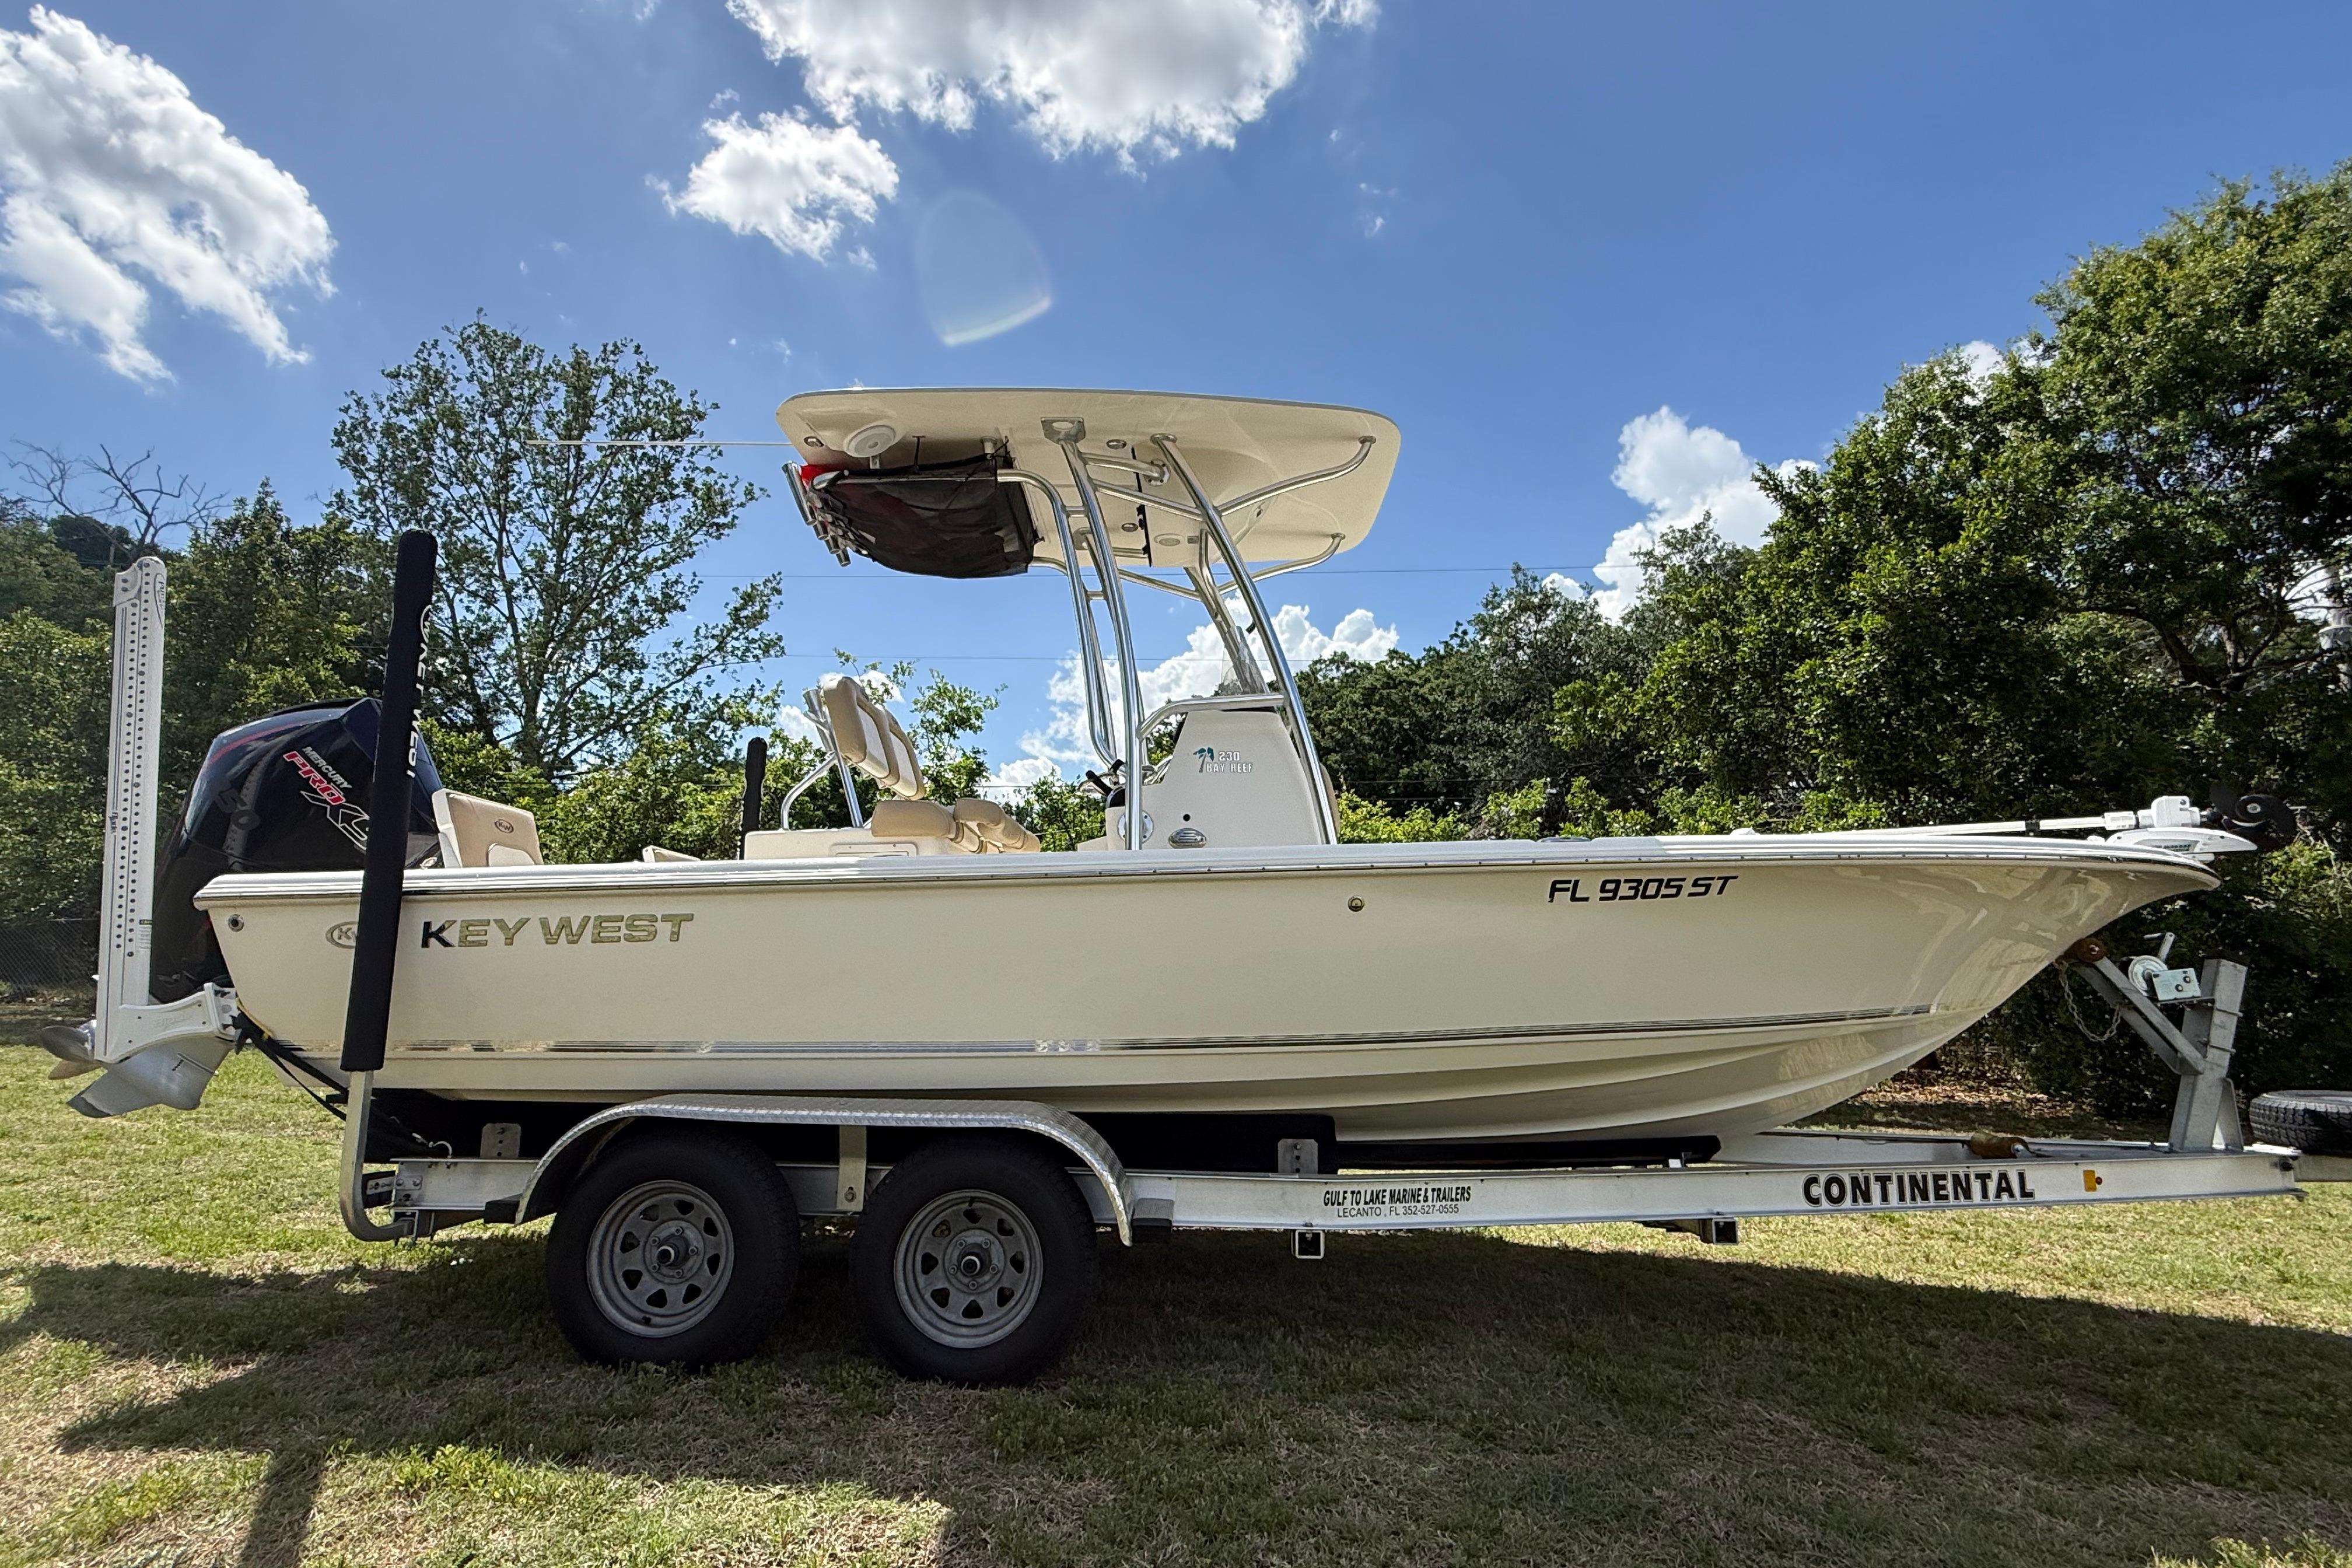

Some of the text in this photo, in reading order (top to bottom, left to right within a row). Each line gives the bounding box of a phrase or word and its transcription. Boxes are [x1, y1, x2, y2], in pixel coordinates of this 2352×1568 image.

[302, 747, 352, 789] MERCURY
[1206, 762, 1253, 773] BAY REEF
[1218, 750, 1241, 761] 230
[283, 750, 346, 806] PRO
[1548, 875, 1739, 903] FL 9305 ST
[421, 913, 694, 949] KEY WEST
[1323, 1186, 1471, 1206] GULF TO LAKE MARINE & TRAILERS
[1801, 1169, 2036, 1208] CONTINENTAL
[1337, 1206, 1382, 1218] LECANTO
[1390, 1205, 1401, 1216] FL
[1402, 1203, 1460, 1216] 352-527-0555
